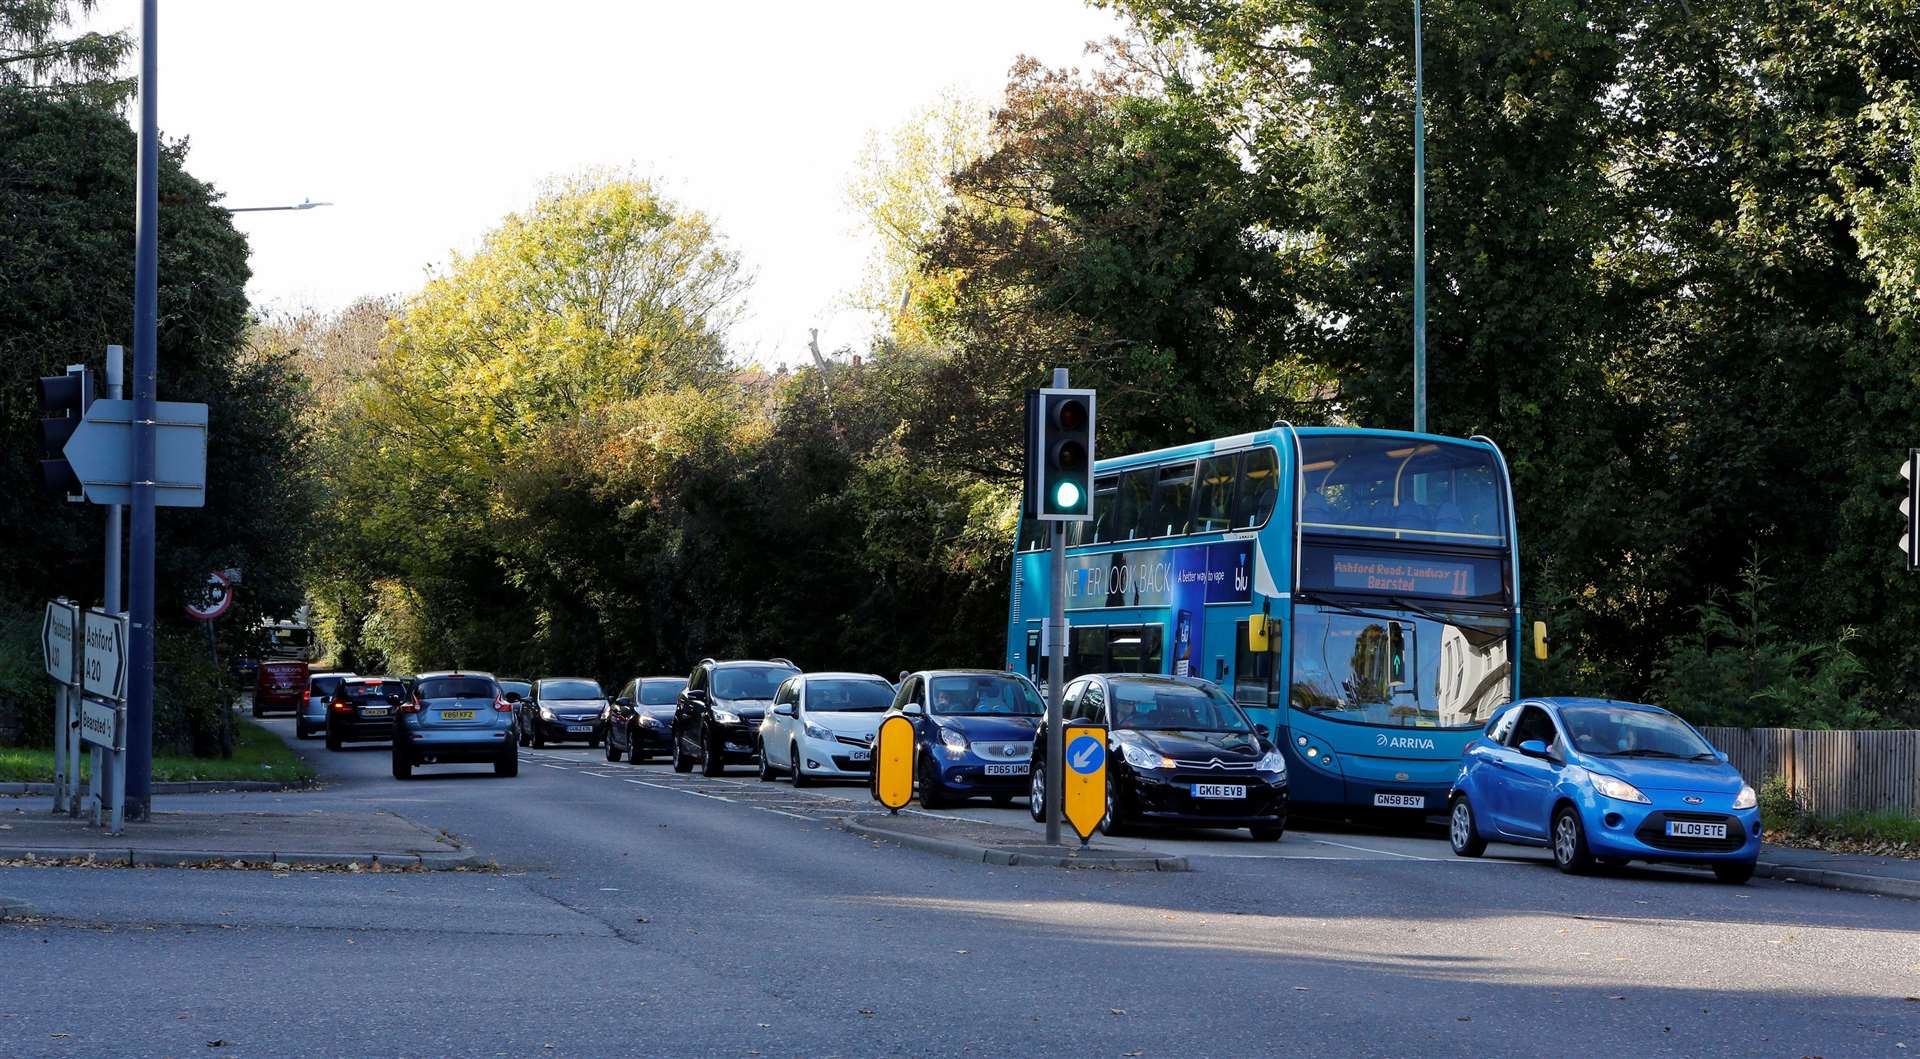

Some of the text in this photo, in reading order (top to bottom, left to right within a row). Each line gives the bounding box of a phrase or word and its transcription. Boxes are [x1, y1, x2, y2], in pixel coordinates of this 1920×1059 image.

[1334, 562, 1374, 574] Ashford
[1104, 564, 1137, 595] LOOK
[1139, 562, 1172, 592] BACK
[1177, 569, 1225, 585] A better way to vape
[1234, 567, 1248, 591] blu
[1368, 576, 1415, 592] Bearsted
[1452, 569, 1468, 595] 11
[86, 626, 113, 653] Ashford
[83, 711, 106, 735] Bearsted
[1390, 737, 1435, 750] ARRIVA
[987, 765, 1011, 775] FD65
[1199, 785, 1243, 797] GK16 EVB
[1377, 794, 1421, 807] GN58 BSY
[1673, 823, 1724, 837] WL09 ETE
